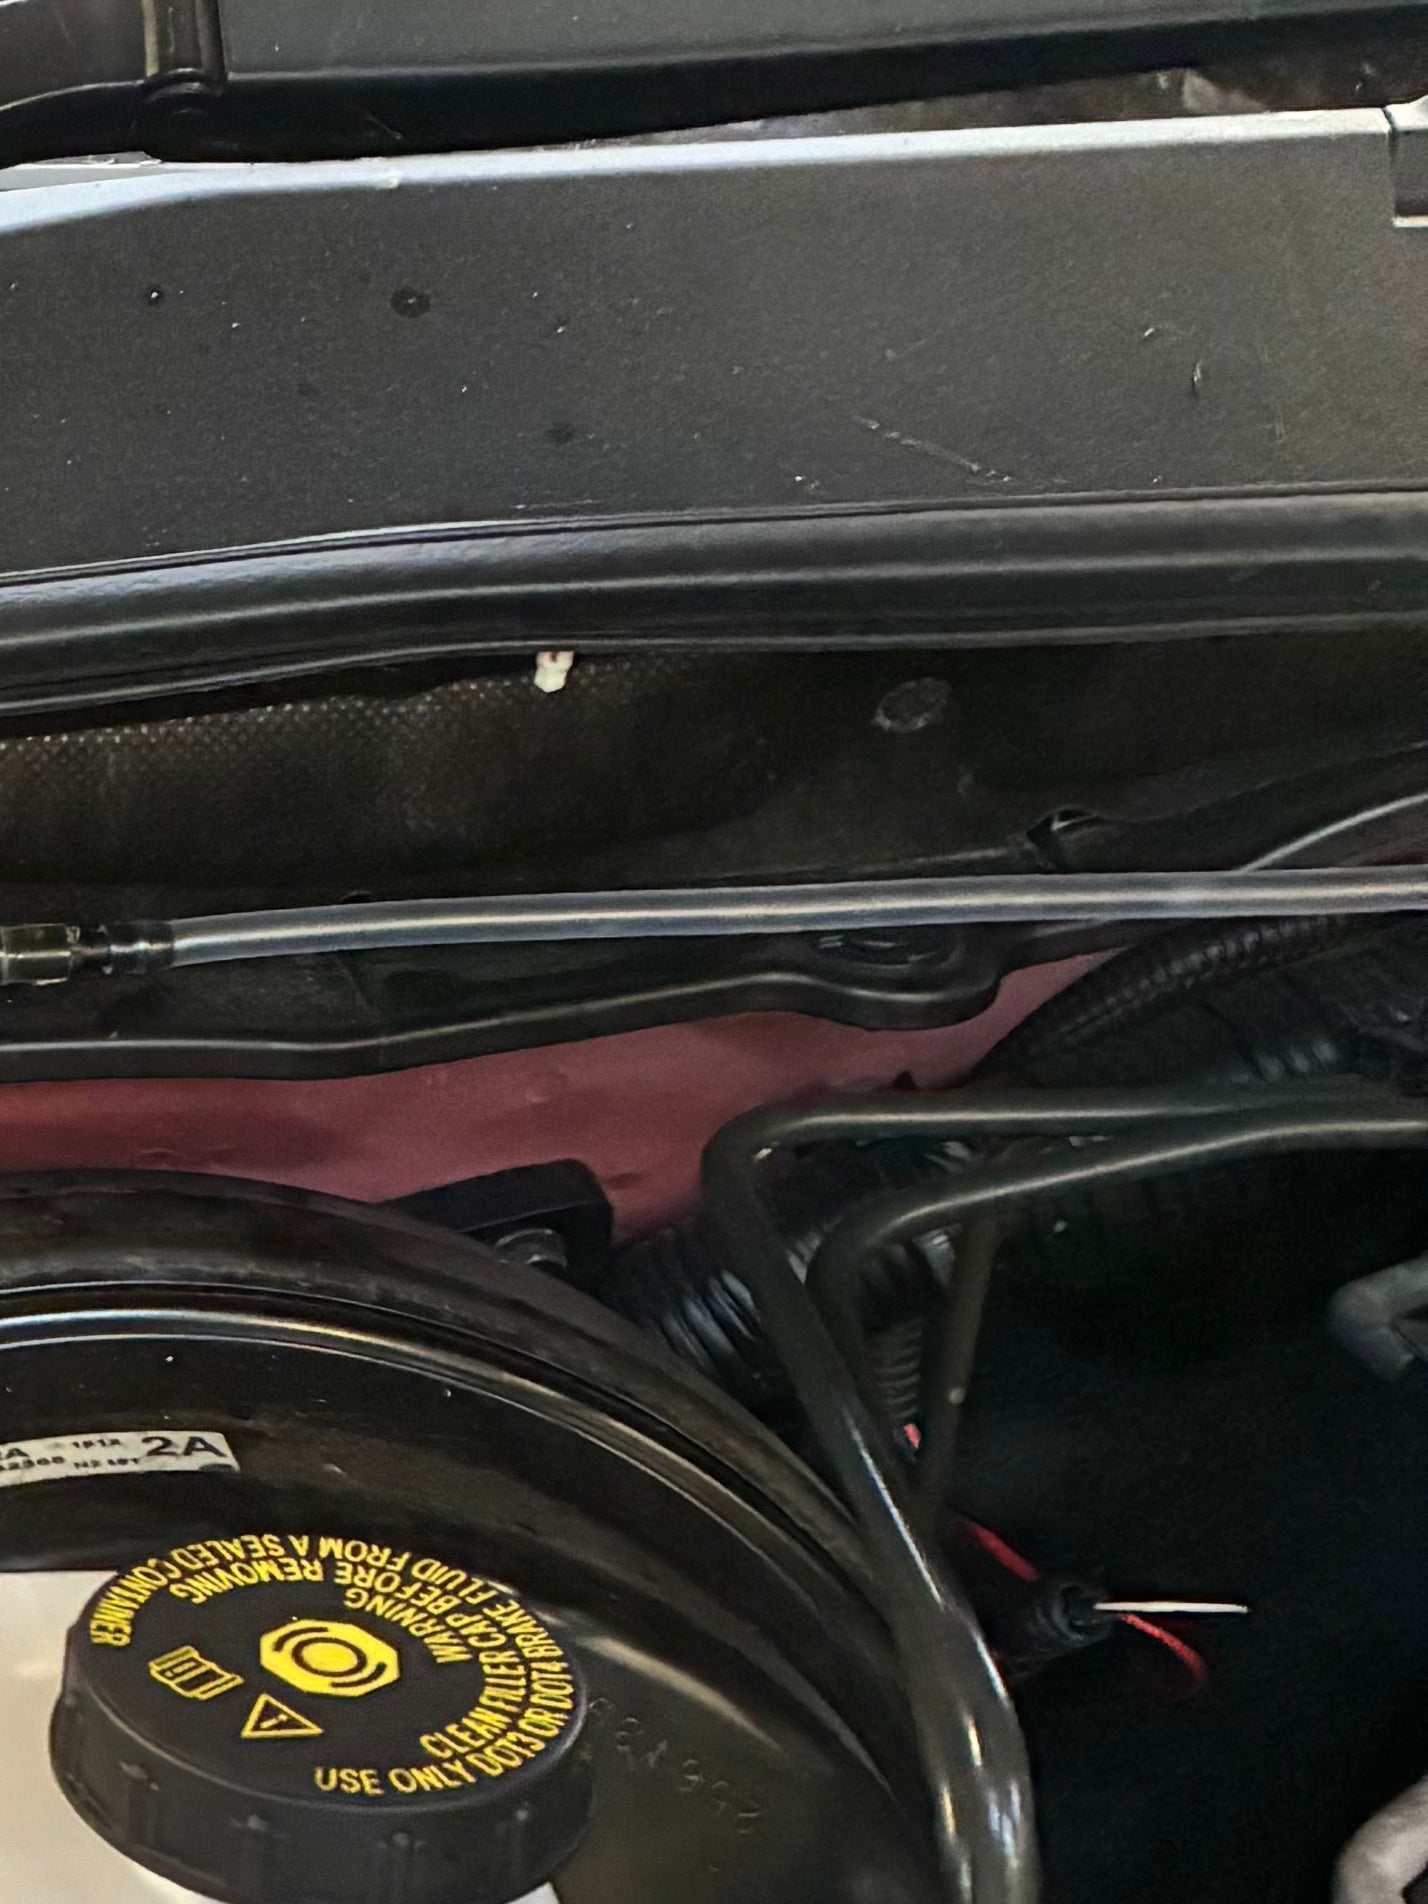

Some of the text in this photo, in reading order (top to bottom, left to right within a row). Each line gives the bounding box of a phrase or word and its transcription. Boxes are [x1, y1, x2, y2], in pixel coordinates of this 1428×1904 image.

[141, 1436, 229, 1458] 2A
[89, 1533, 574, 1795] USE ONLY DOT3 OR DOT4 BRAKE FLUID FROM A SEALED CONTAINER
[169, 1557, 528, 1759] CLEAN FILLER CAP BEFORE REMOVING
[343, 1587, 473, 1664] WARNING
